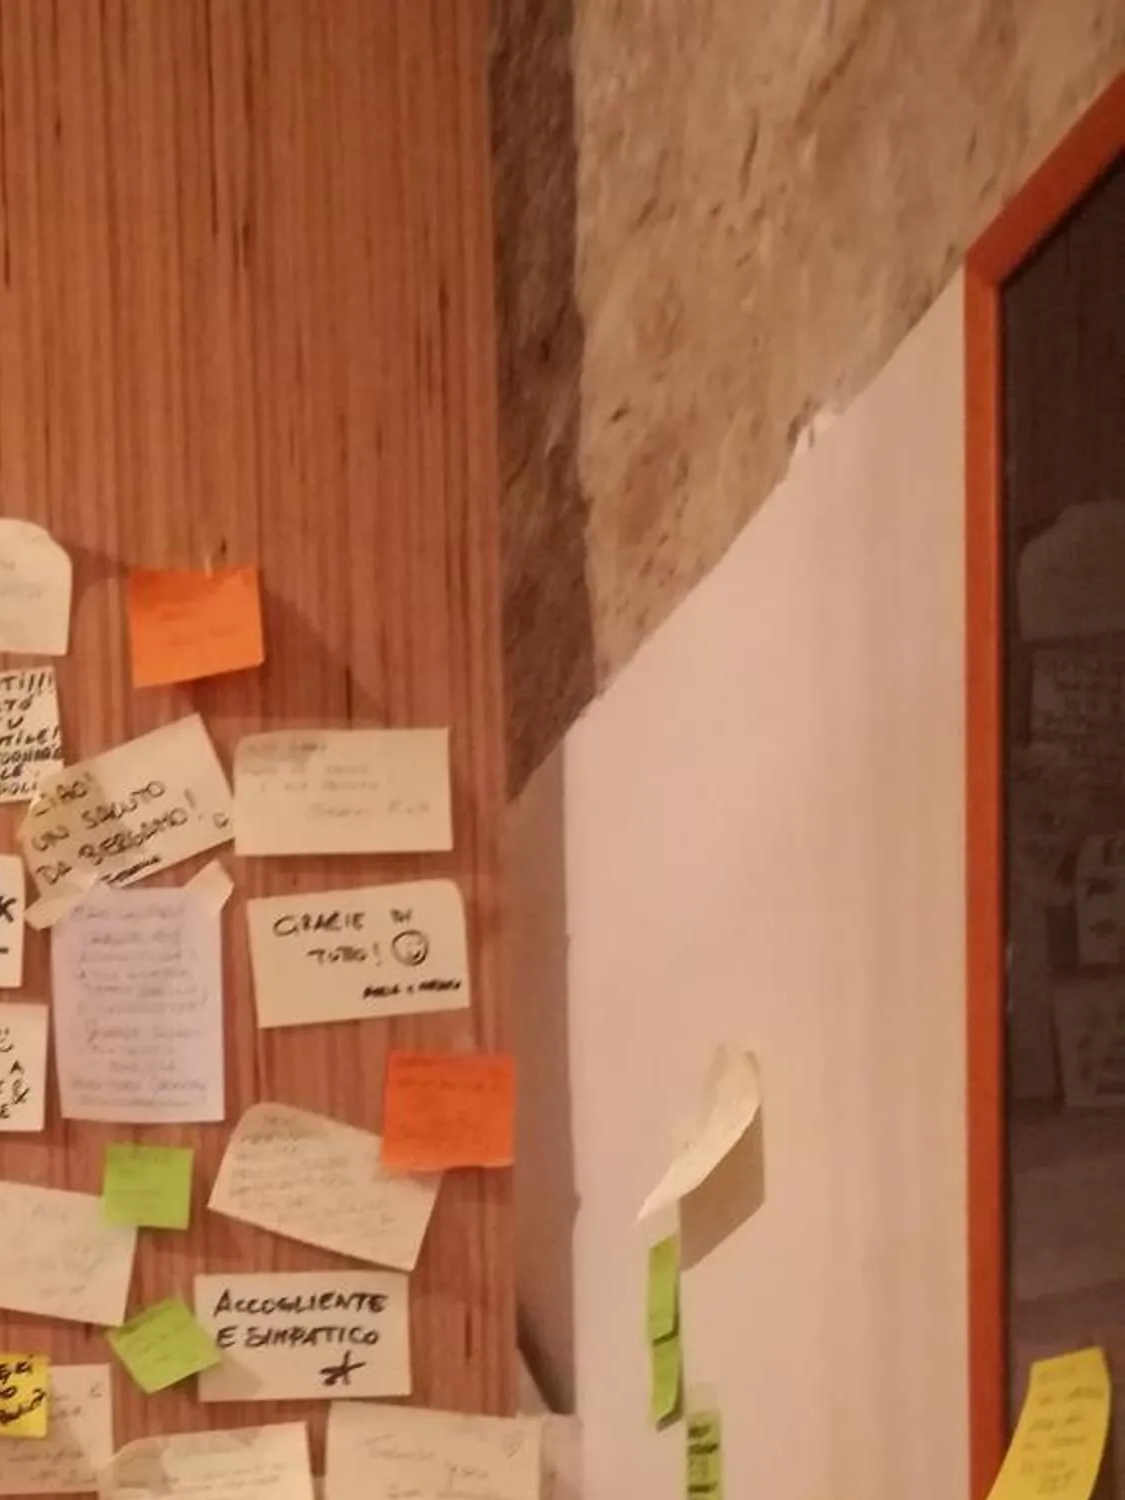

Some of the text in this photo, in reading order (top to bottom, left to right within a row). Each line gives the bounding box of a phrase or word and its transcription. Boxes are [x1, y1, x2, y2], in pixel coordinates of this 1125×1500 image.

[213, 1289, 388, 1318] ACCOGLIENTE
[216, 1325, 380, 1349] E SIMPATICO
